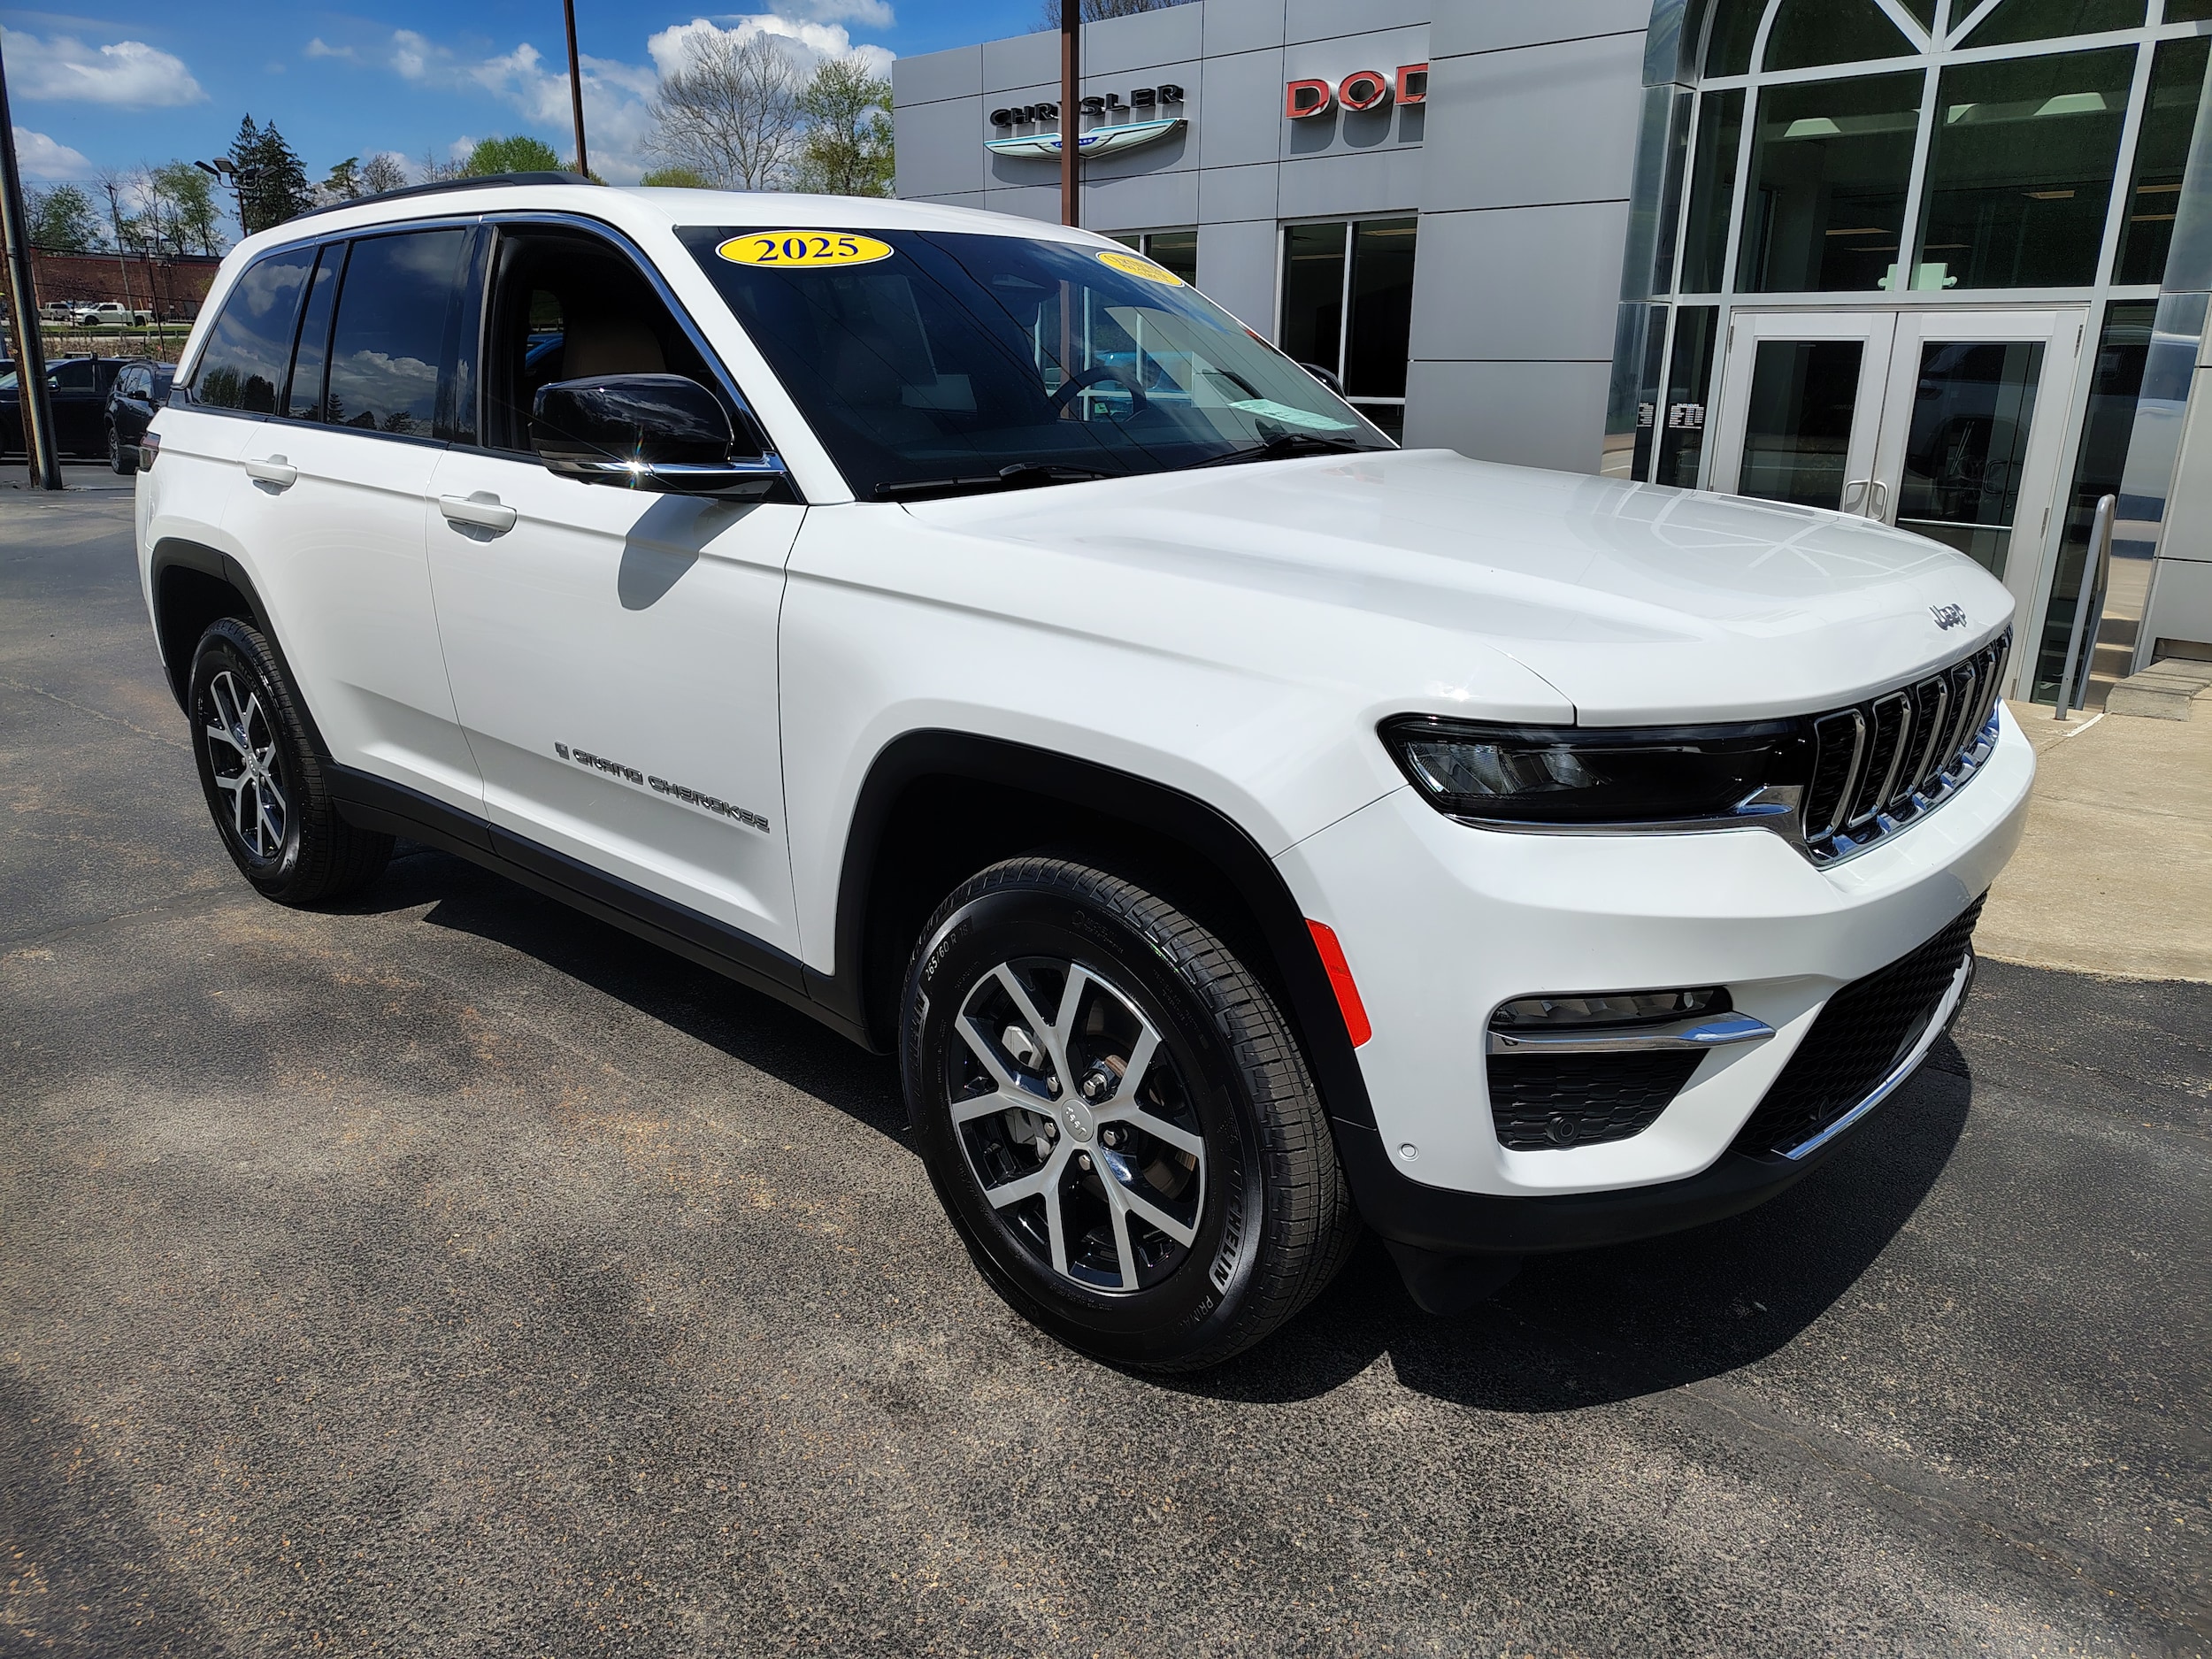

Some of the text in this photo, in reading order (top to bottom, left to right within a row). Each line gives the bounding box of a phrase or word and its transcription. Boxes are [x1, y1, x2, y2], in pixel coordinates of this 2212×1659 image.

[990, 84, 1184, 127] CHRSLER
[753, 237, 859, 262] 2025
[1929, 603, 1967, 631] Jeep
[572, 749, 771, 834] GRAND CHEROKEE
[925, 941, 950, 982] 265/60
